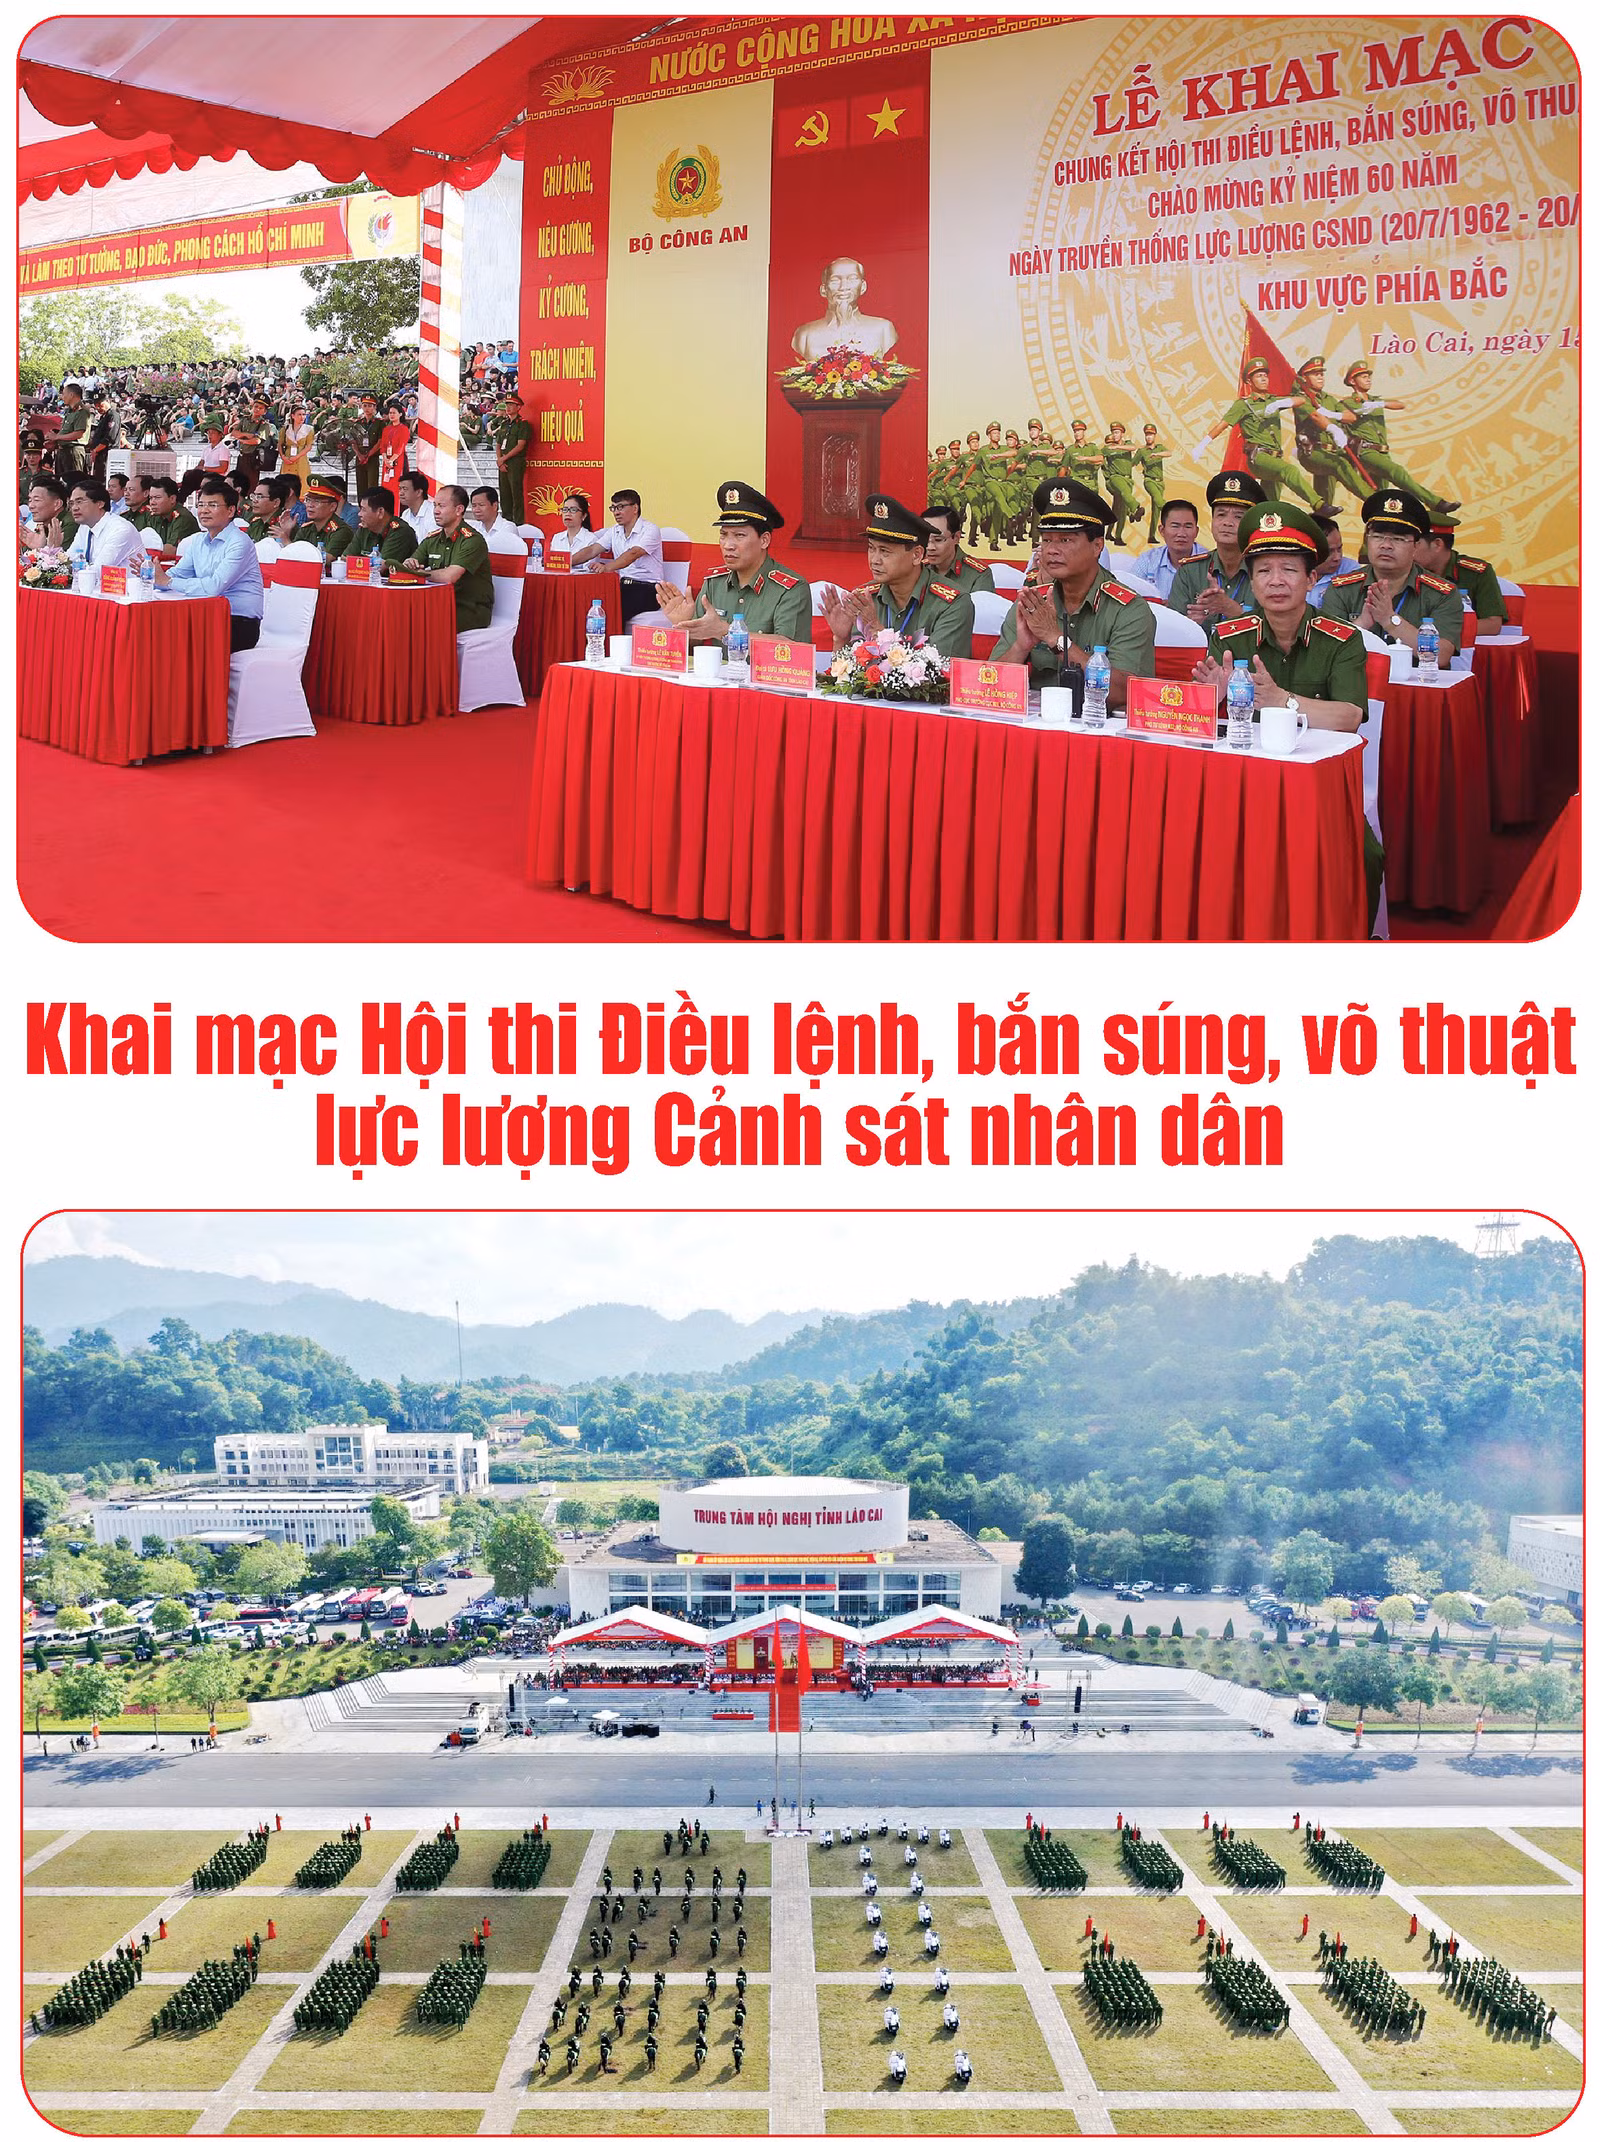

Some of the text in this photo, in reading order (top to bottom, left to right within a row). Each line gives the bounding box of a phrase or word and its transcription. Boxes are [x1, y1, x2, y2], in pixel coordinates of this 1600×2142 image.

[650, 42, 726, 84] NƯỚC
[736, 24, 820, 68] CỘNG
[1092, 18, 1534, 136] LỄ KHAI MẠC
[1054, 154, 1112, 186] CHUNG
[1118, 142, 1150, 177] KẾT
[1156, 139, 1186, 176] HỘI
[1192, 138, 1221, 166] THI
[1228, 124, 1273, 162] ĐIỀU
[1280, 120, 1340, 159] LỆNH,
[1347, 104, 1394, 146] BẮN
[1402, 100, 1475, 137] SÚNG,
[1483, 87, 1516, 126] VÕ
[543, 155, 594, 200] CHỦ ĐỘNG,
[1148, 152, 1457, 218] CHÀO MỪNG KỶ NIỆM 60 NĂM
[32, 258, 50, 283] LÀM
[52, 256, 74, 280] THEO
[76, 253, 88, 276] TƯ
[90, 244, 122, 273] TƯỞNG,
[125, 250, 144, 274] ĐẠO
[148, 238, 172, 266] ĐỨC,
[173, 238, 210, 263] PHONG
[214, 230, 244, 258] CÁCH
[248, 222, 263, 254] HỒ
[267, 221, 287, 252] CHÍ
[290, 222, 325, 249] MINH
[538, 220, 594, 258] NÊU GƯƠNG,
[629, 225, 748, 254] BỘ CÔNG AN
[1010, 245, 1052, 276] NGÀY
[1058, 233, 1122, 272] TRUYỀN
[1128, 228, 1188, 266] THỐNG
[1196, 228, 1230, 264] LỰC
[1238, 222, 1304, 259] LƯỢNG
[1313, 216, 1372, 248] CSND
[1381, 202, 1510, 246] (20/7/1962
[539, 274, 589, 319] KỶ CƯƠNG,
[1258, 256, 1507, 313] KHU VỰC PHÍA BẮC
[530, 340, 596, 386] TRÁCH NHIỆM,
[1370, 334, 1416, 354] Lào
[1426, 332, 1474, 354] Cai,
[1483, 332, 1550, 356] ngày
[540, 399, 584, 450] HIỆU QUẢ
[985, 688, 990, 697] LÊ
[1178, 712, 1192, 722] NGỌC
[694, 1510, 726, 1524] TRUNG
[730, 1508, 754, 1525] TÂM
[758, 1508, 778, 1528] HỘI
[782, 1512, 812, 1528] NGHỊ
[816, 1506, 842, 1524] TỈNH
[868, 1508, 882, 1522] CAI
